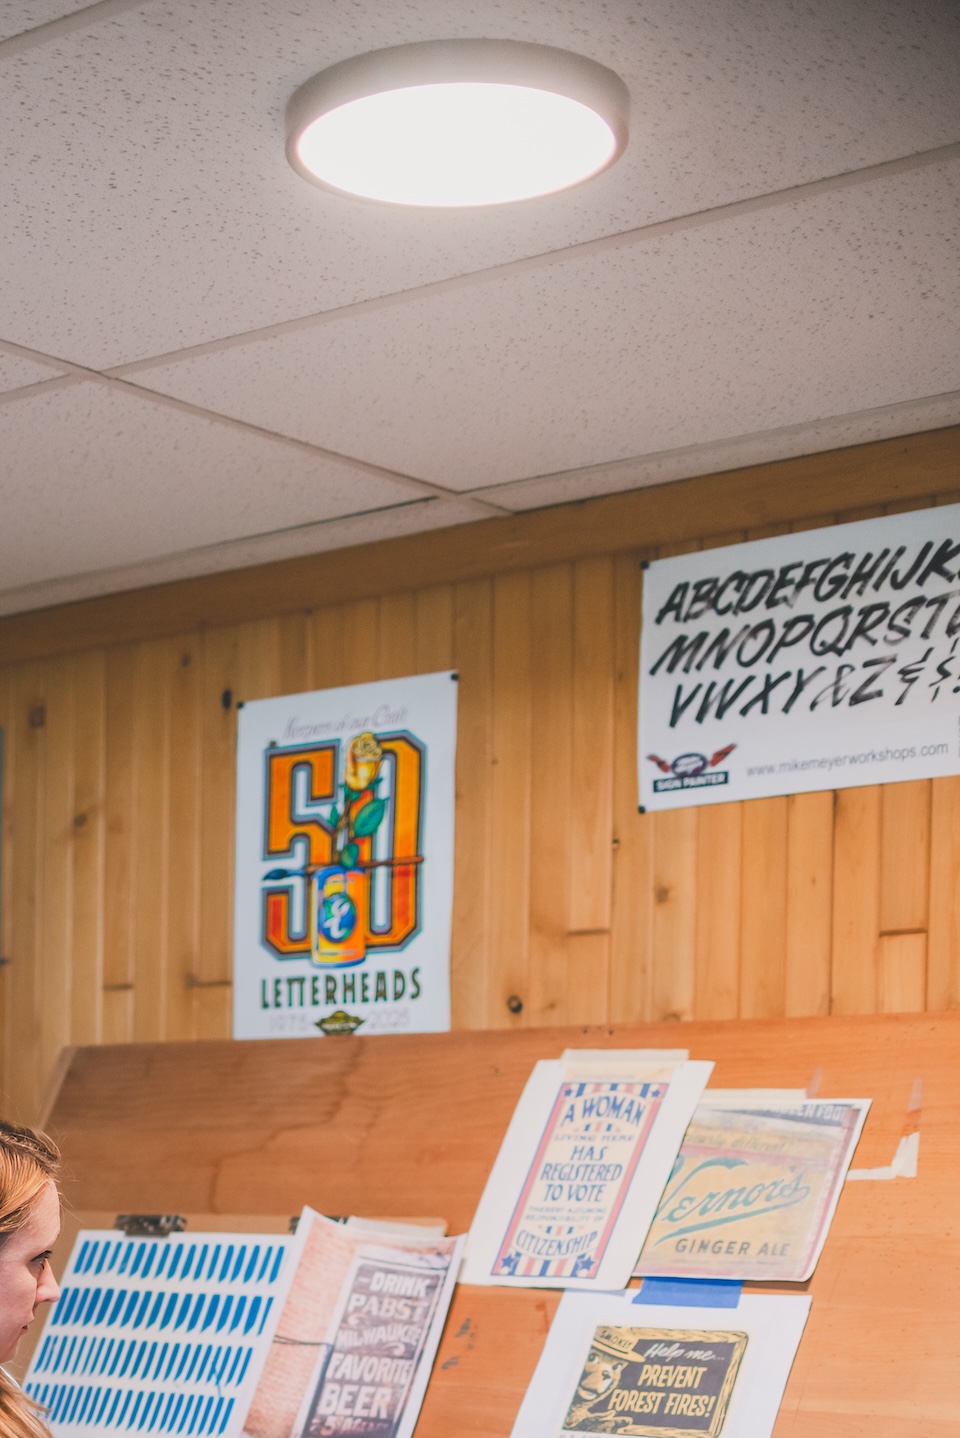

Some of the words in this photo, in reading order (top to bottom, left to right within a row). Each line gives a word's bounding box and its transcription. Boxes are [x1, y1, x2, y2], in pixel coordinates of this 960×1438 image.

[655, 537, 960, 625] ABCDEFGHIJK
[745, 741, 949, 778] www.mikemeyerworkshops.com
[261, 967, 422, 1010] LETTERHEADS
[559, 1102, 576, 1128] A
[581, 1095, 647, 1129] WOMAN
[554, 1133, 597, 1142] LIVING
[600, 1133, 635, 1142] HERE
[569, 1145, 609, 1161] HAS
[539, 1163, 624, 1182] REGISTERED
[543, 1184, 564, 1202] TO
[567, 1184, 607, 1203] VOTE
[515, 1229, 598, 1257] CITIZENSHIP
[675, 1238, 751, 1256] GINGER
[758, 1242, 791, 1257] ALE
[369, 1271, 431, 1299] DRINK
[347, 1292, 429, 1321] PABST
[599, 1329, 633, 1351] SMOKEY
[644, 1342, 685, 1363] Help
[326, 1351, 414, 1385] FAVORITE
[637, 1363, 707, 1389] PREVENT
[317, 1381, 393, 1419] BEER
[607, 1388, 665, 1414] FOREST
[664, 1392, 717, 1418] FIRES!
